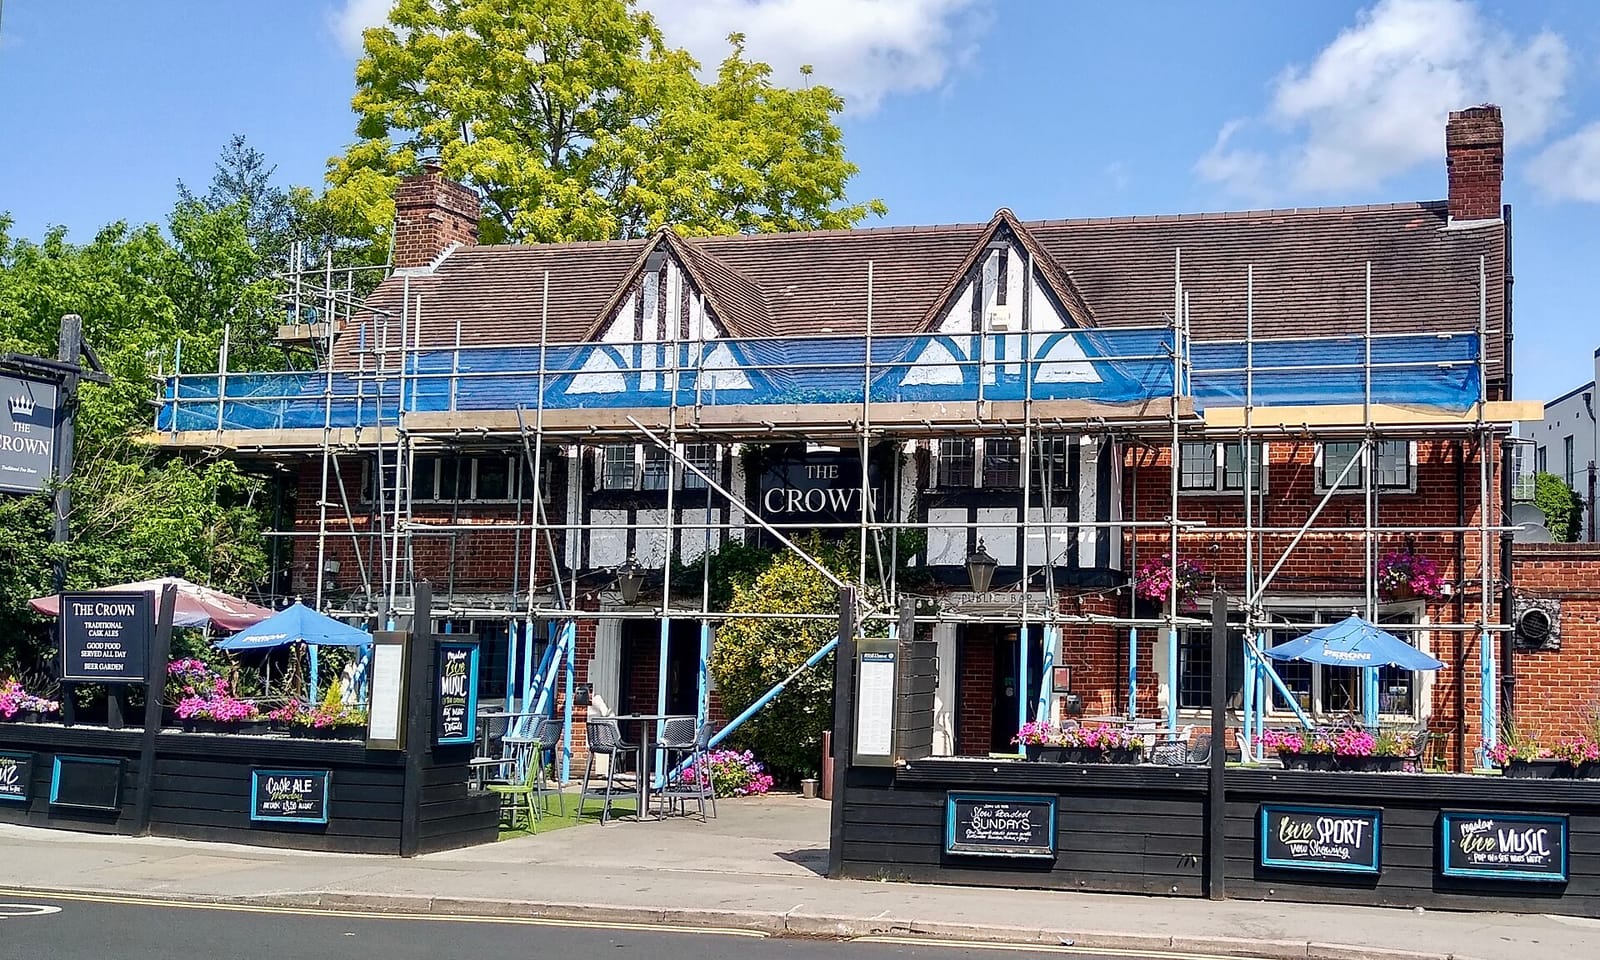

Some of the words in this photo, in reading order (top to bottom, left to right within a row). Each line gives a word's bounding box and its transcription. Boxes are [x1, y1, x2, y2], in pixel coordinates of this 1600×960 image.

[13, 421, 31, 433] THE
[805, 465, 839, 479] THE
[764, 487, 879, 513] CROWN
[961, 592, 1001, 604] PUBLIC
[86, 642, 104, 650] GOOD
[104, 642, 121, 650] FOOD
[1323, 649, 1372, 660] PERONI
[441, 675, 467, 697] MUSIC
[292, 779, 312, 793] ALE
[971, 818, 1031, 831] SUNDAYS
[1317, 816, 1369, 849] SPORT
[1498, 828, 1551, 856] MUSIC
